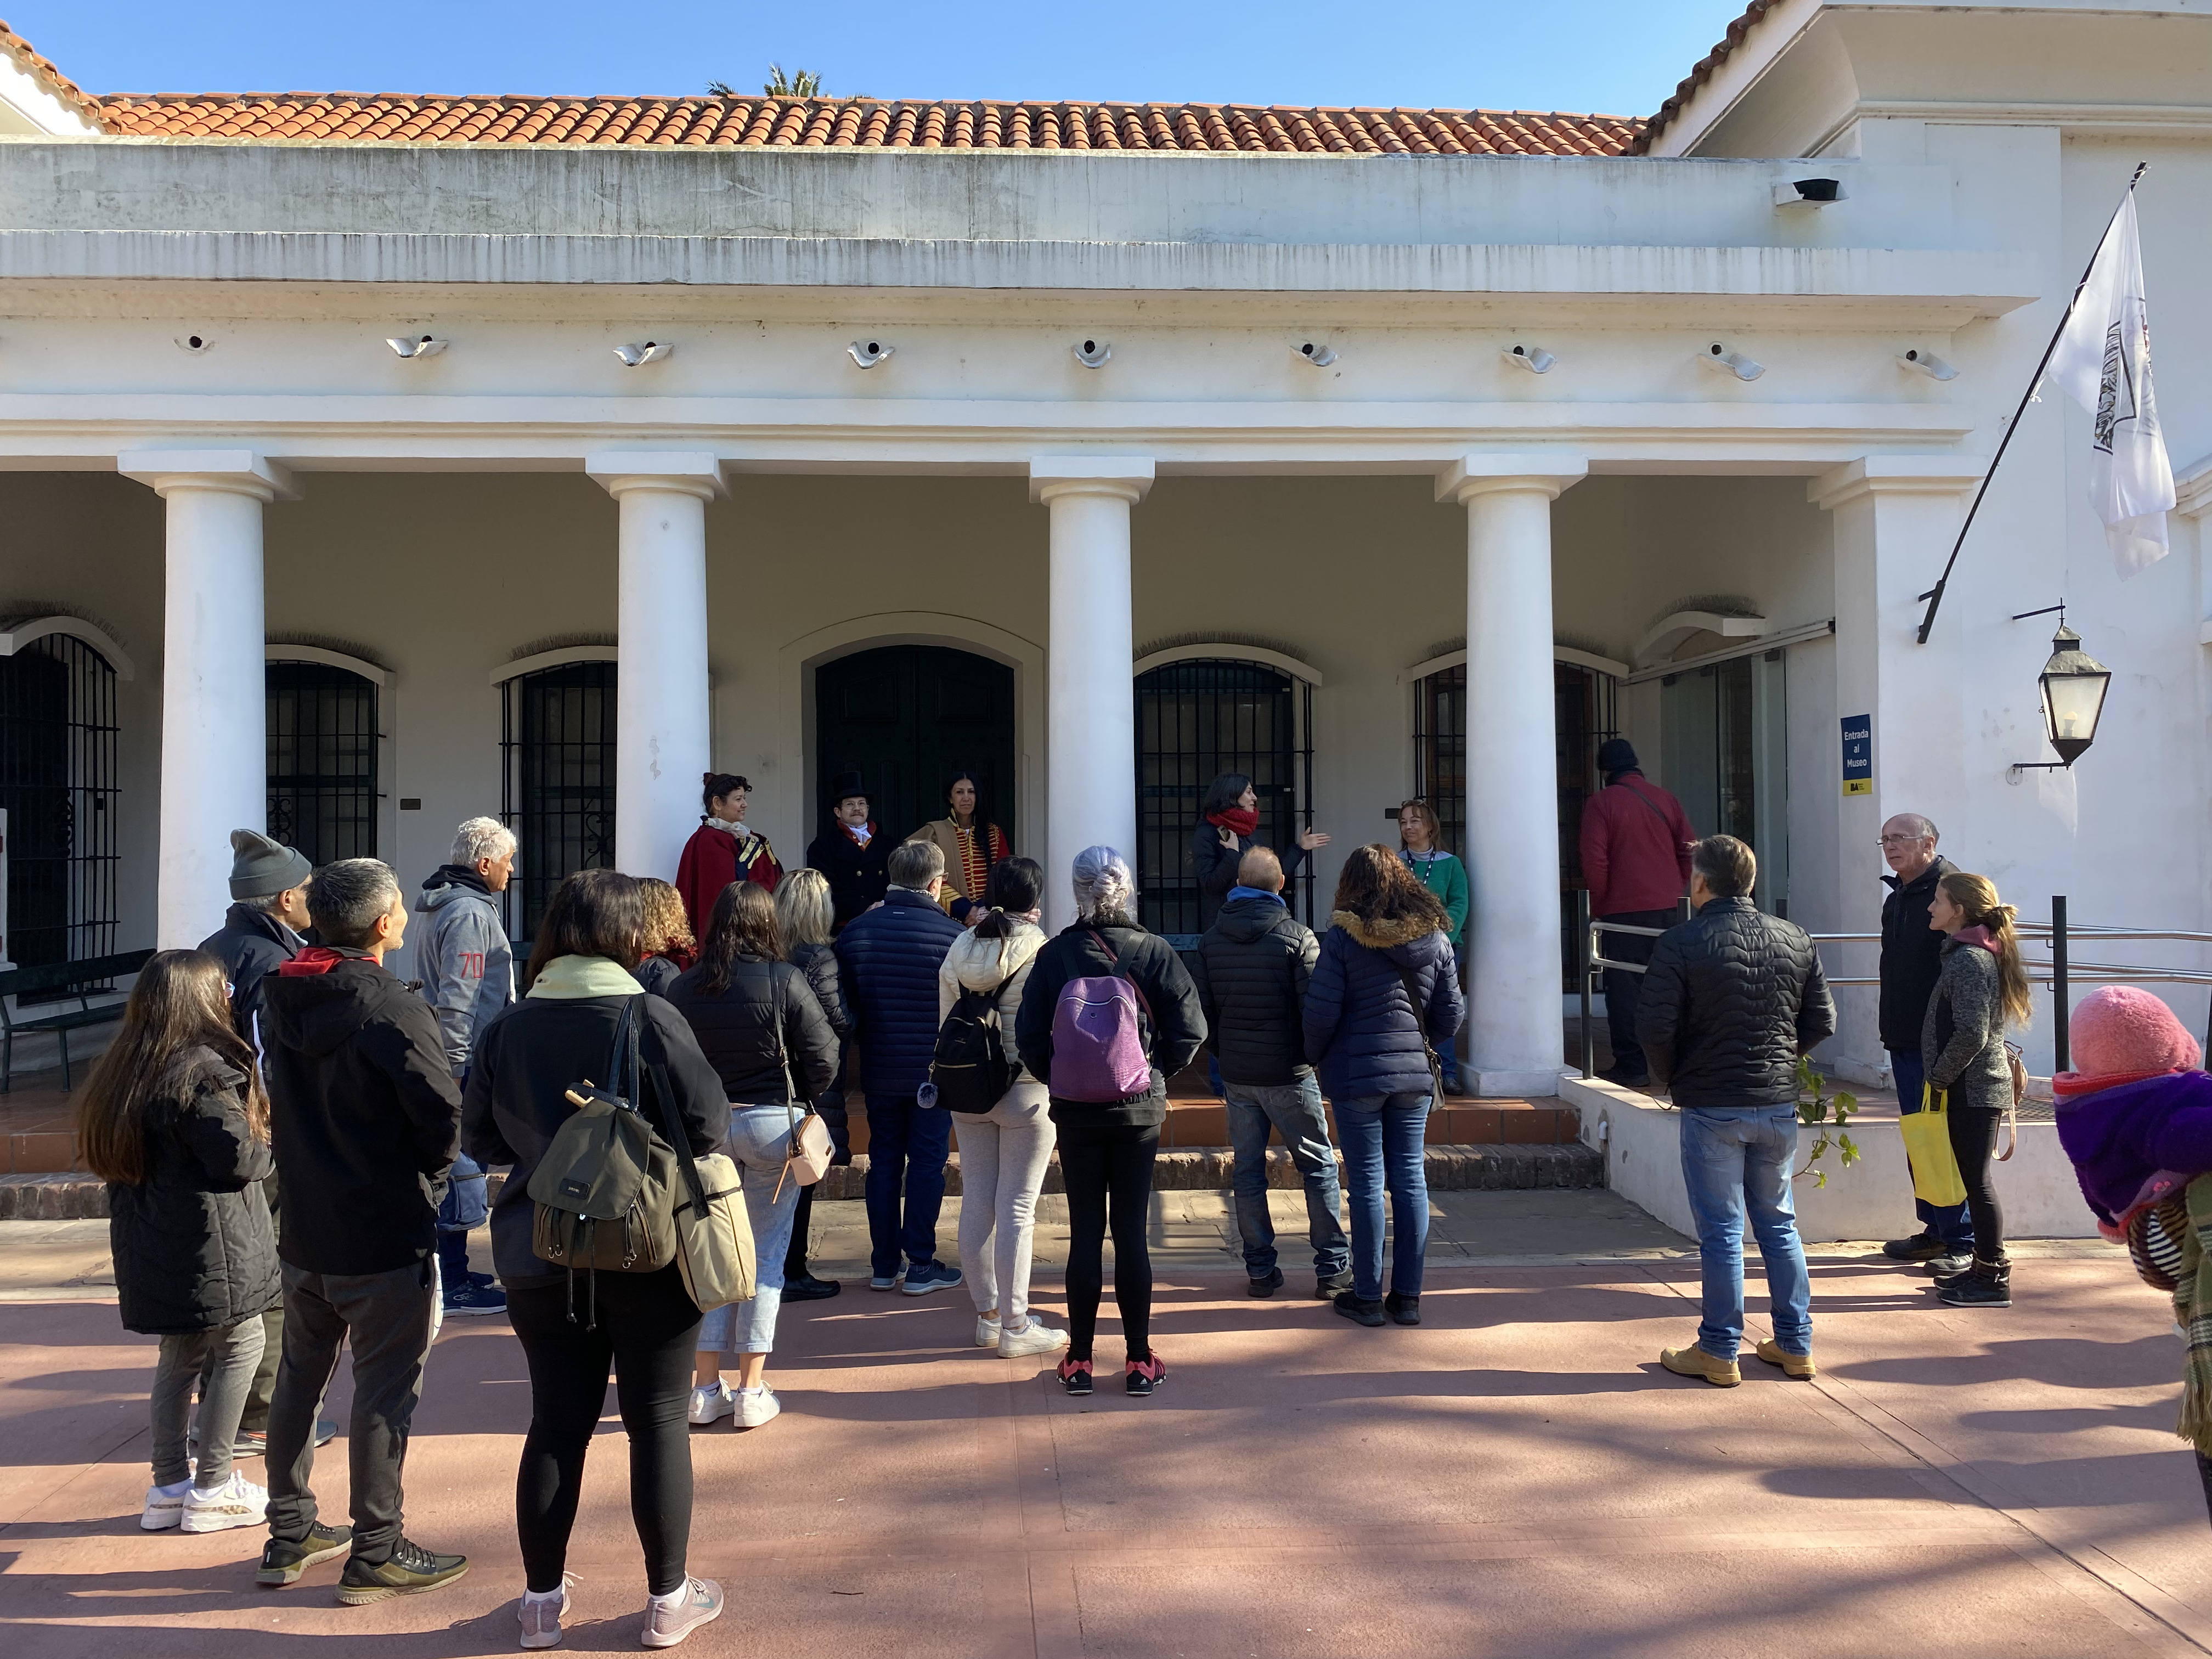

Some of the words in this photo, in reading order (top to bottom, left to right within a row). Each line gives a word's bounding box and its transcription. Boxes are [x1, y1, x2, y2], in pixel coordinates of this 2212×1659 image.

[1844, 729, 1869, 741] Entrada
[1854, 744, 1860, 753] al
[1847, 759, 1867, 768] Museo
[458, 952, 483, 979] 70
